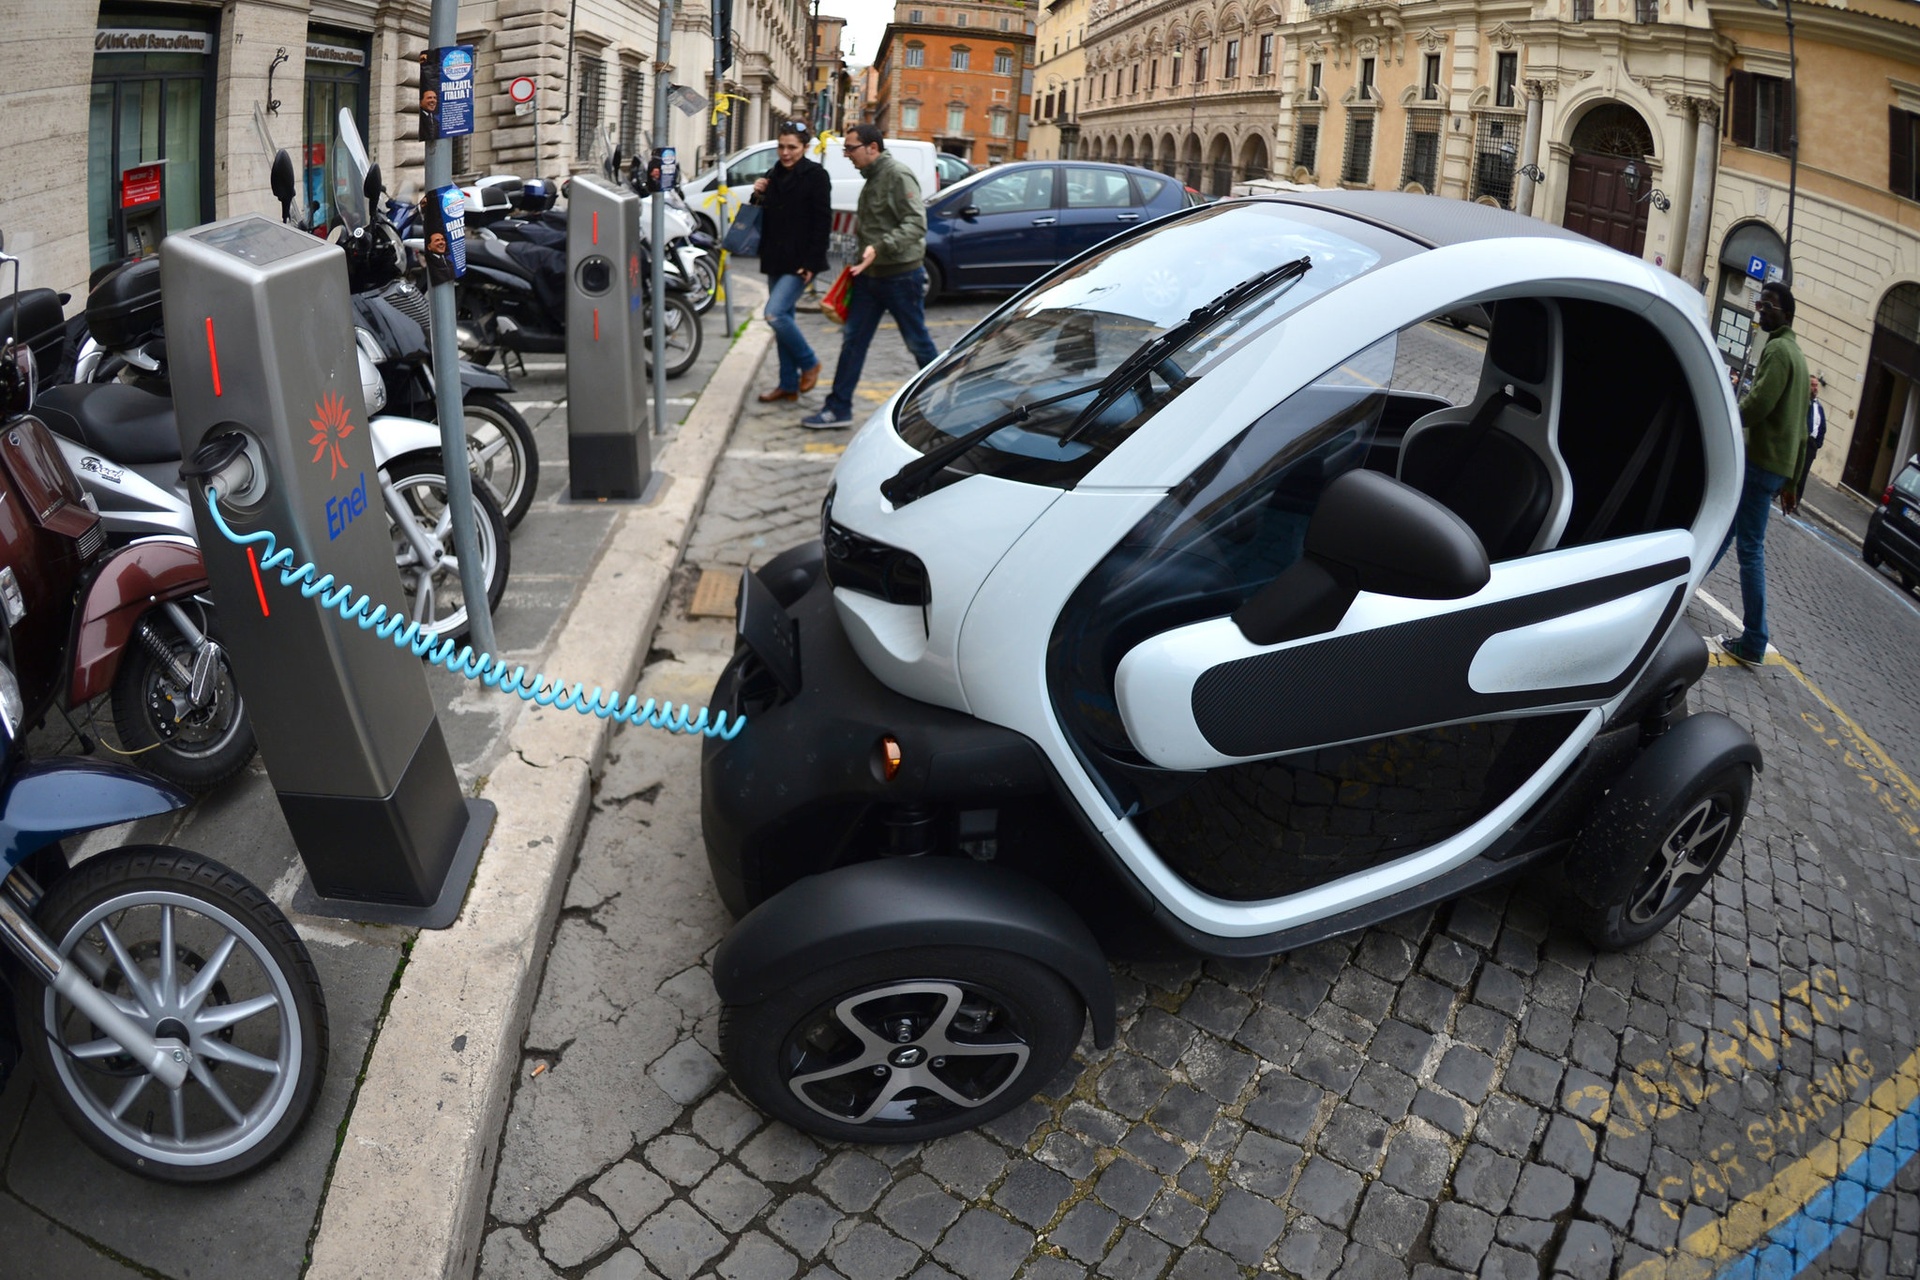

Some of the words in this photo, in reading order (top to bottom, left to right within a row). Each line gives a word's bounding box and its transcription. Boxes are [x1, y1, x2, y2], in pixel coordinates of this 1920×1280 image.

[441, 80, 472, 92] RIALZATI,
[444, 89, 465, 101] ITALIA
[1751, 259, 1763, 273] P
[325, 471, 368, 541] Enel
[1565, 967, 1851, 1152] RISERVATO
